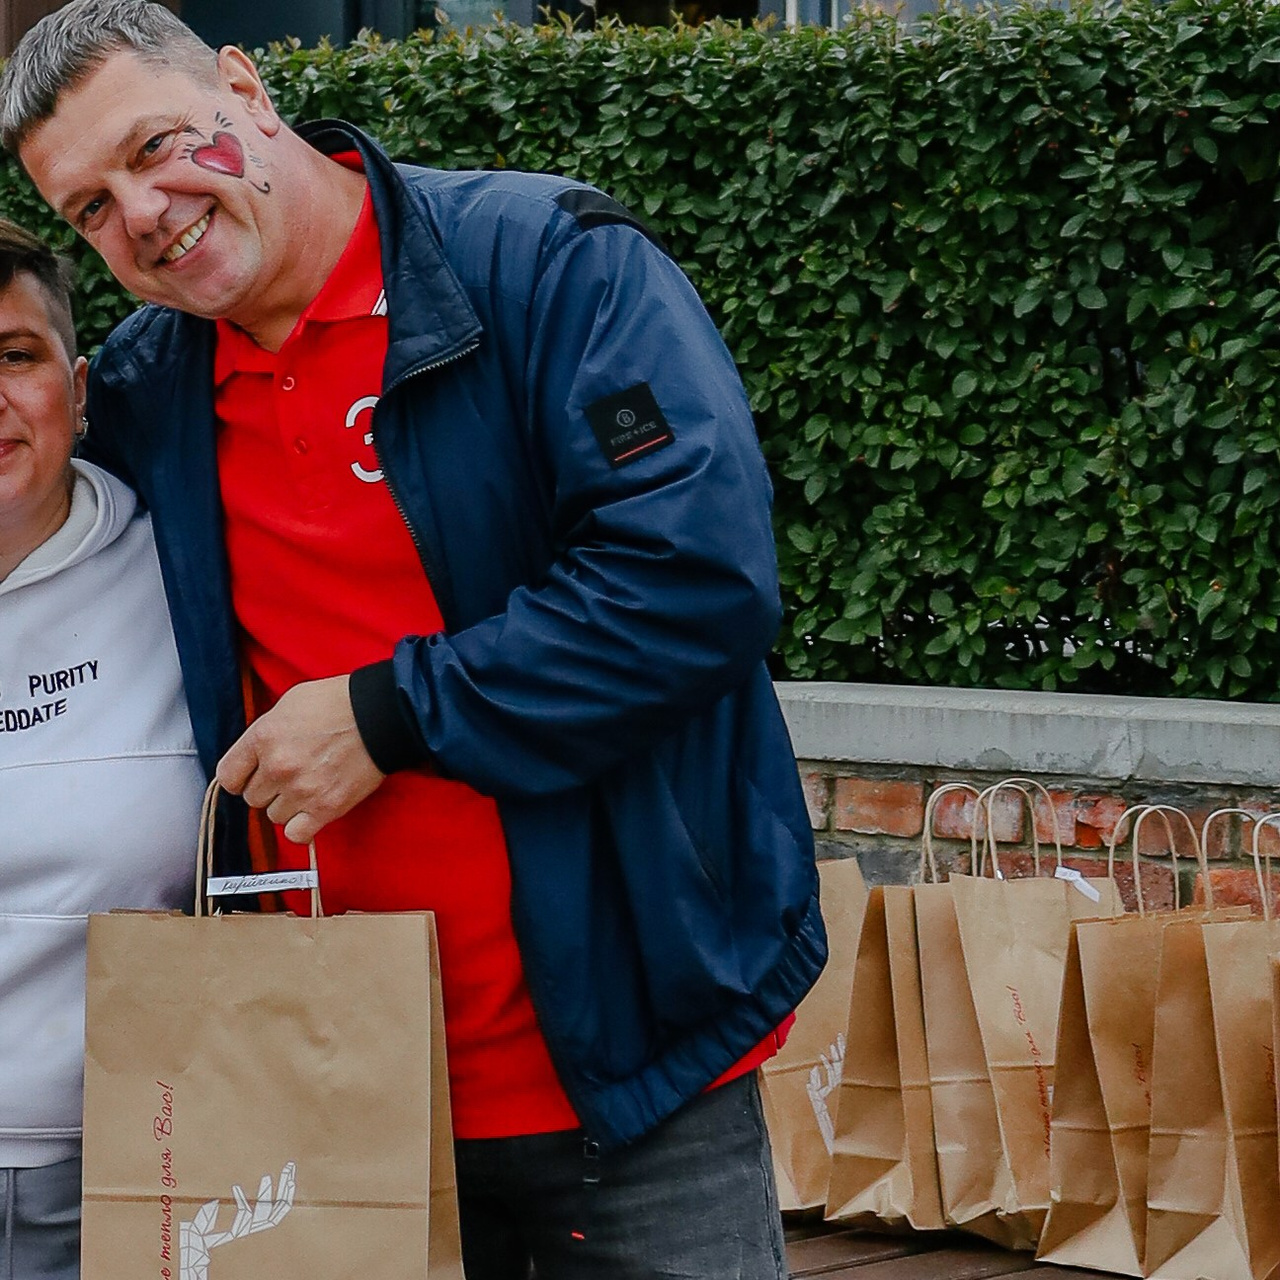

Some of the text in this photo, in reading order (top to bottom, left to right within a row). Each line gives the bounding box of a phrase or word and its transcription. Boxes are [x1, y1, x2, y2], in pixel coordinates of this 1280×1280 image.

[28, 660, 99, 698] PURITY
[153, 1080, 174, 1141] Вас!
[161, 1148, 176, 1188] для
[160, 1194, 172, 1261] тепло
